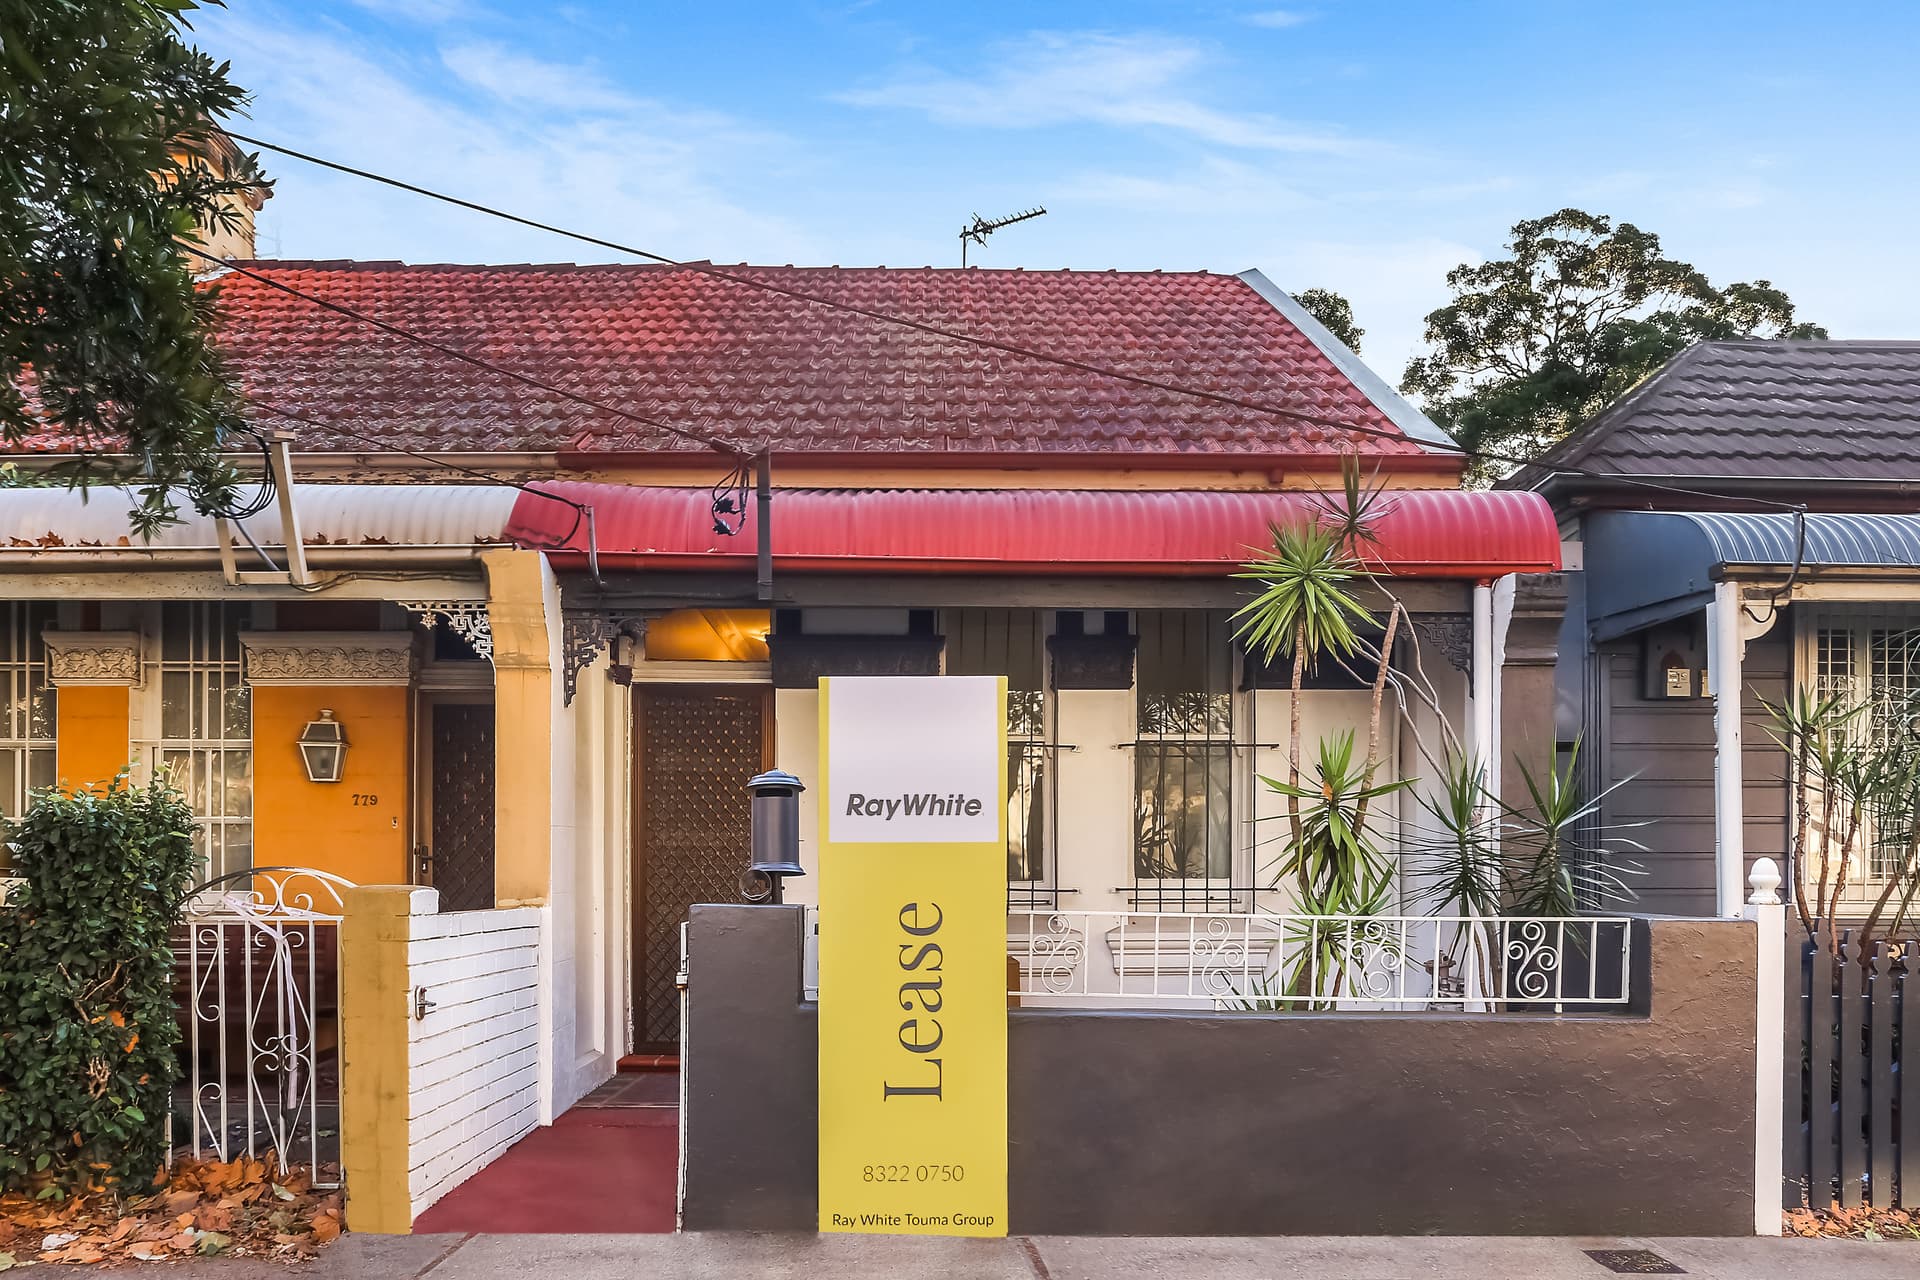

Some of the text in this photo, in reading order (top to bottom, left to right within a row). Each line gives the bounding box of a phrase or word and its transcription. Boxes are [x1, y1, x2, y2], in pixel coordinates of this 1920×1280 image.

[351, 793, 378, 807] 779
[883, 902, 943, 1102] Lease
[862, 1165, 964, 1182] 8322 0750
[832, 1213, 995, 1228] Ray White Touma Group
